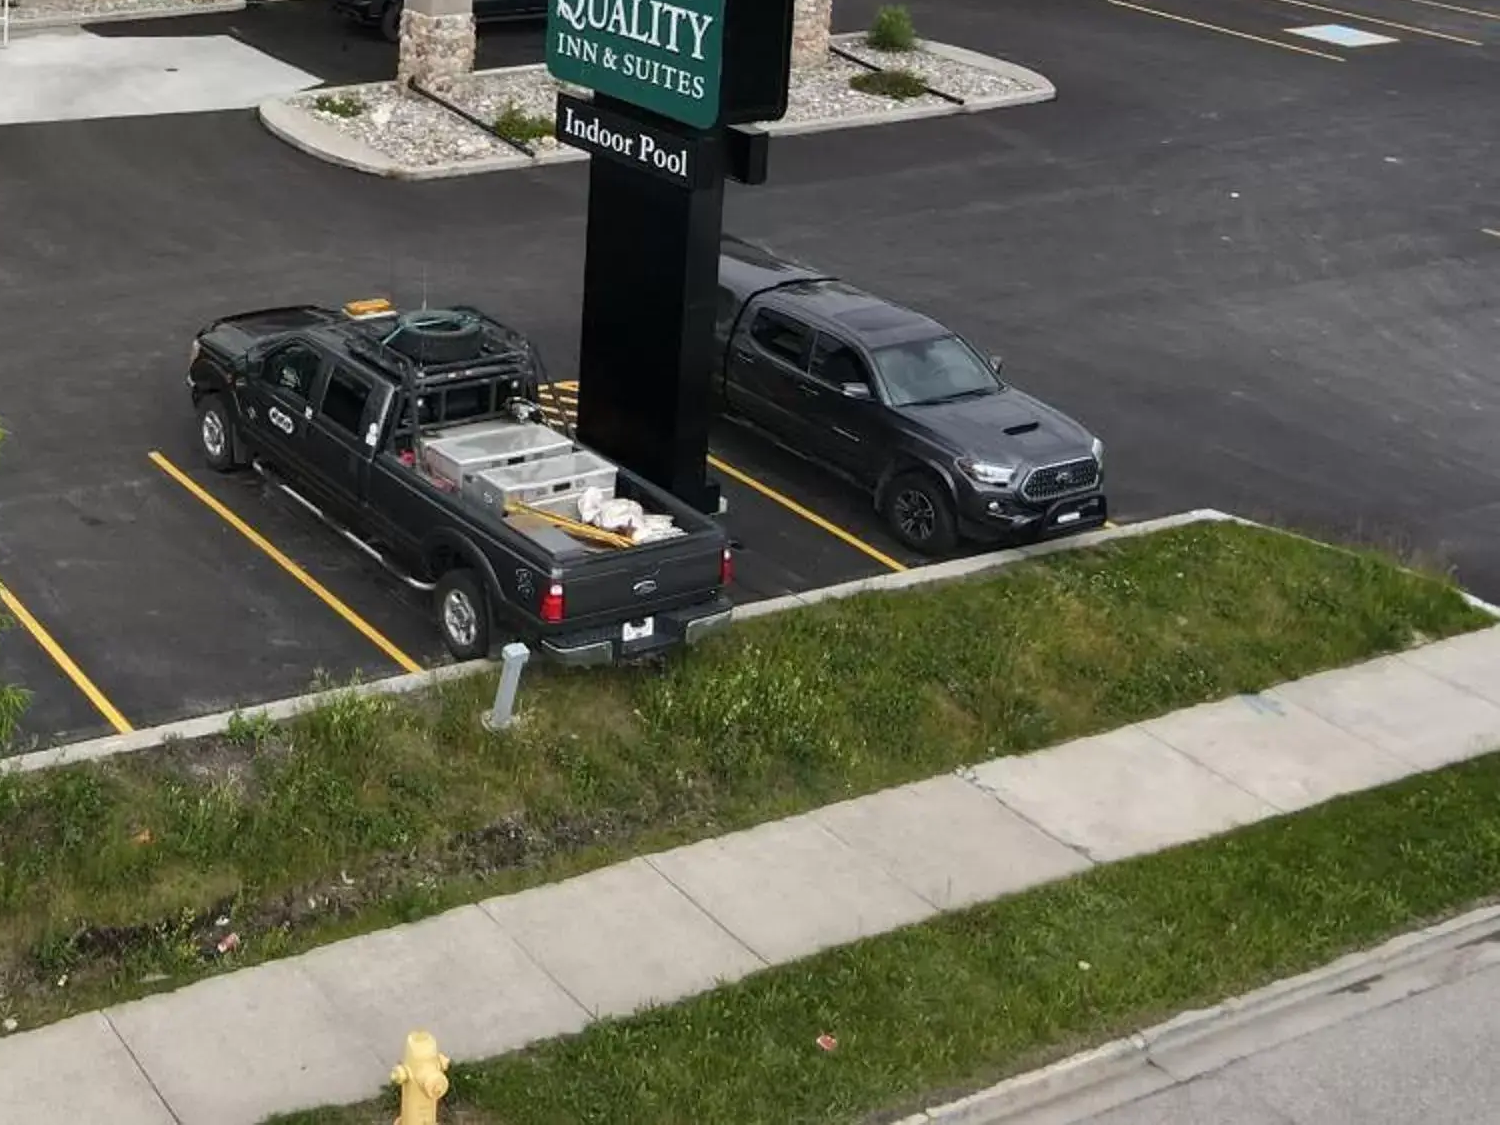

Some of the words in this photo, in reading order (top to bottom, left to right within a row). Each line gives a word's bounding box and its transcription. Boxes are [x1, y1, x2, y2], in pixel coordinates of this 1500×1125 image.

[557, 32, 598, 64] INN
[603, 47, 617, 71] &
[623, 54, 705, 99] SUITES
[565, 107, 633, 156] Indoor
[638, 134, 687, 176] Pool
